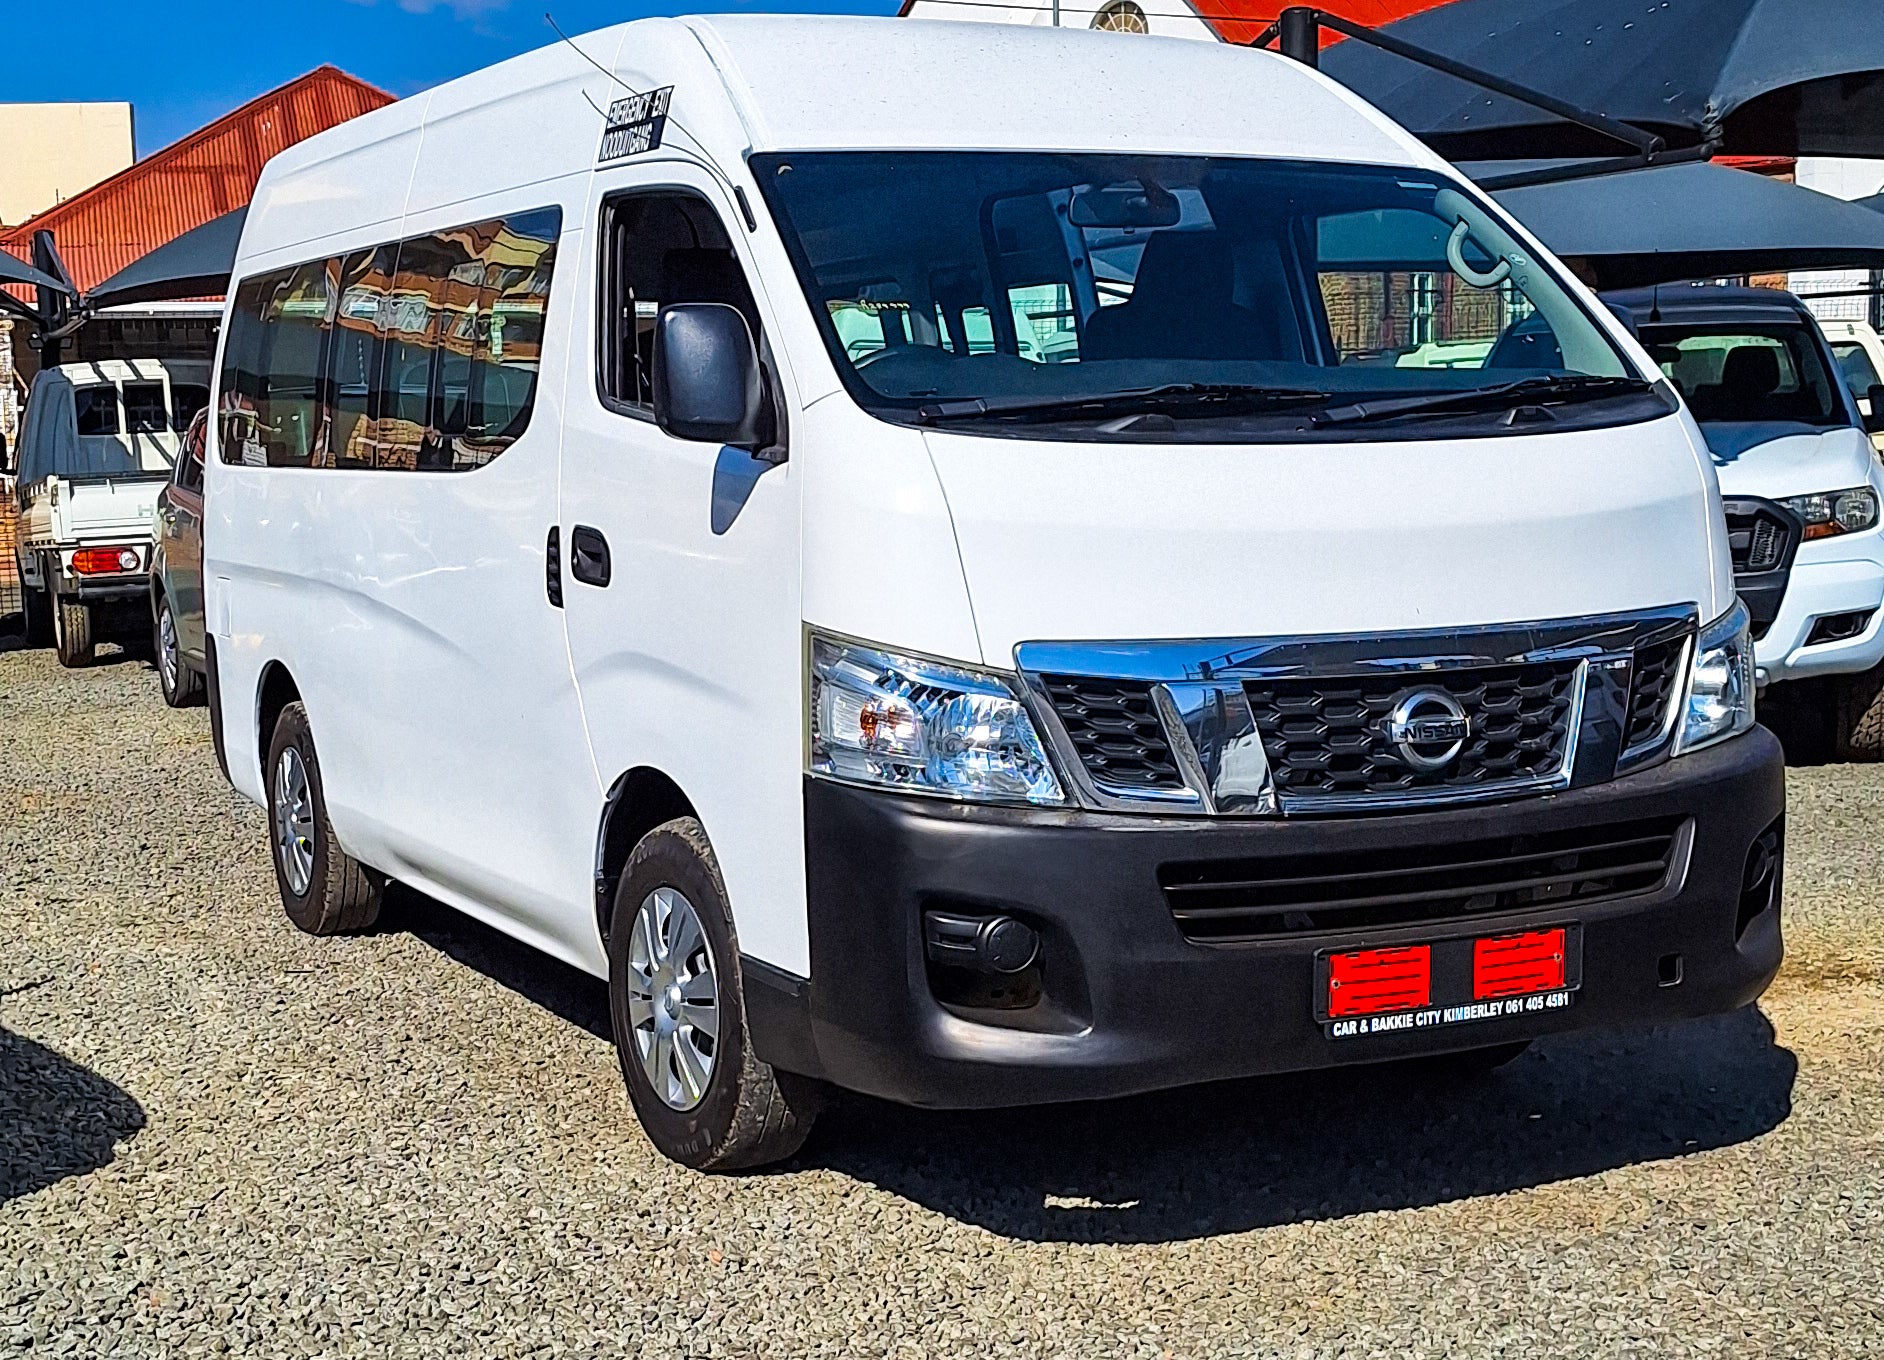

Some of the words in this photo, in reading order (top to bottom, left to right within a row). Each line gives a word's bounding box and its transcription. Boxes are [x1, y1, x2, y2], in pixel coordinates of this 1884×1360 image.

[1404, 724, 1466, 739] NISSAN
[1333, 1020, 1358, 1037] CAR
[1359, 1019, 1369, 1033] &
[1371, 1013, 1414, 1032] BAKKIE
[1415, 1009, 1442, 1026] CITY
[1443, 1001, 1503, 1023] KIMBERLEY
[1505, 998, 1523, 1014] 061
[1526, 995, 1544, 1011] 405
[1545, 991, 1569, 1008] 4581
